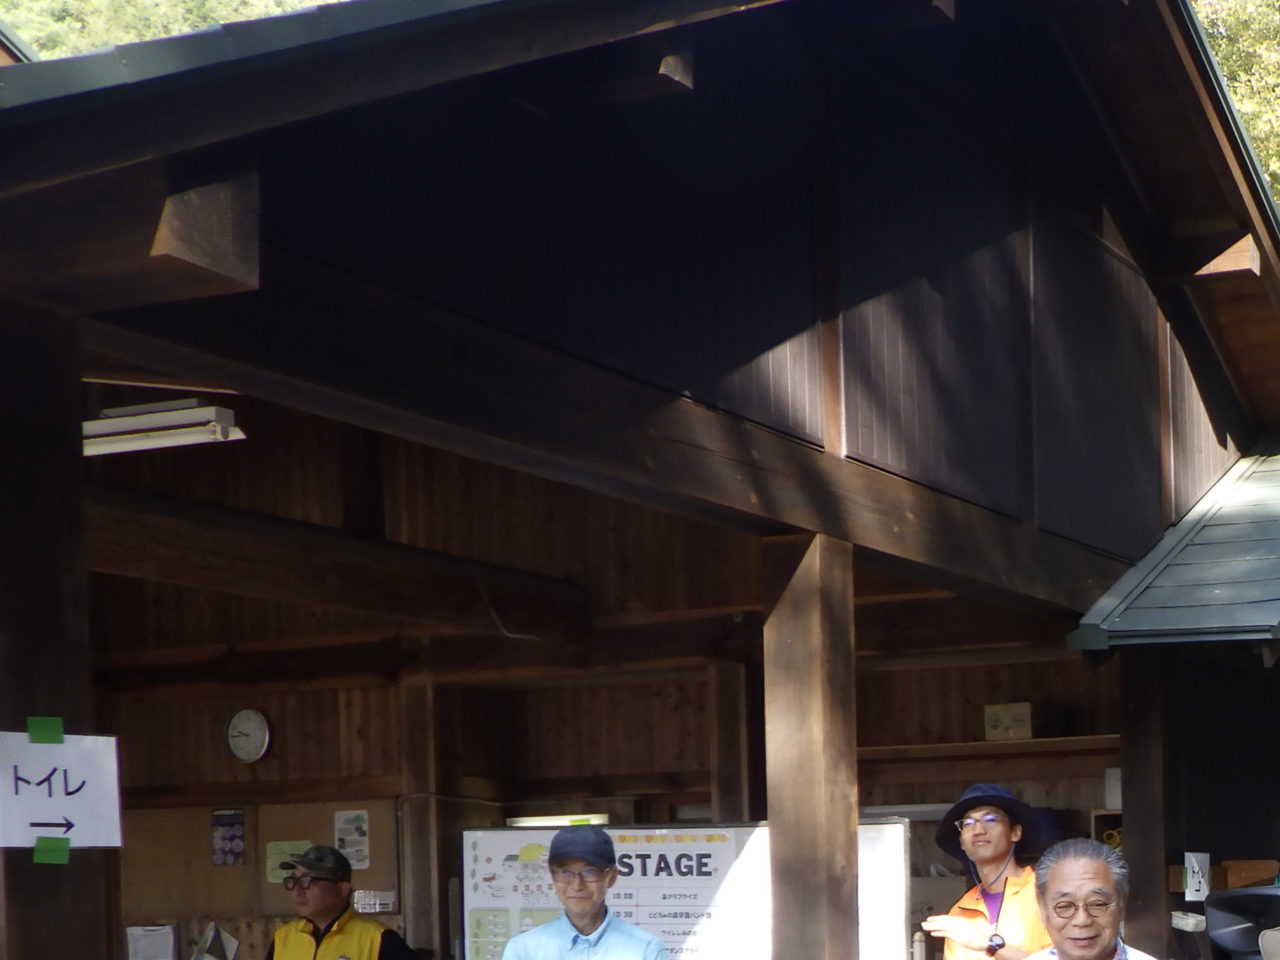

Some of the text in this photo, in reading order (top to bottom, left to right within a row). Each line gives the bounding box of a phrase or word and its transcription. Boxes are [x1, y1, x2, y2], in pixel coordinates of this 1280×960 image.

[13, 764, 87, 798] トイレ
[617, 852, 713, 877] STAGE
